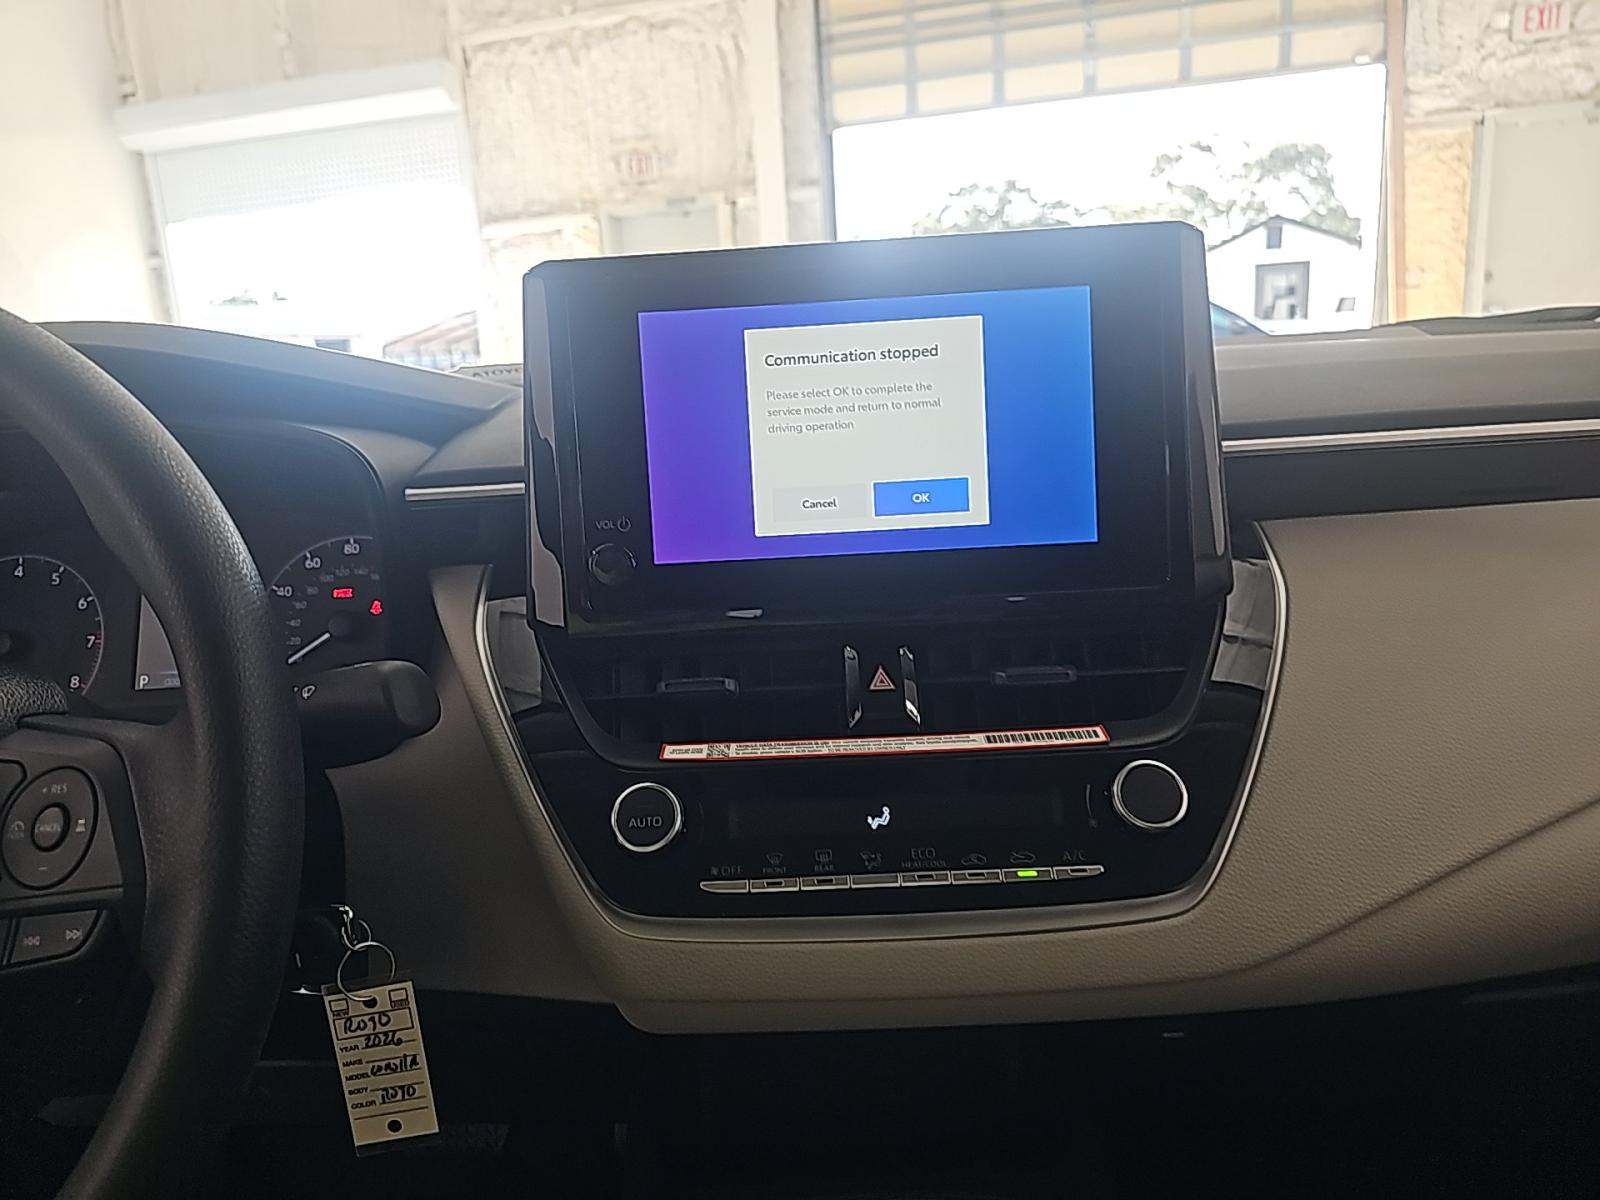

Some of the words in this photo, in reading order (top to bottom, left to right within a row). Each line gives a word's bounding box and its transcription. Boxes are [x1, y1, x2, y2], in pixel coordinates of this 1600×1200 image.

[1524, 1, 1563, 33] EXIT
[764, 350, 876, 367] Communication
[879, 344, 939, 361] stopped
[766, 388, 799, 401] Please
[801, 387, 831, 399] select
[832, 387, 850, 397] OK
[851, 386, 863, 396] to
[864, 383, 914, 397] complete
[915, 381, 933, 392] the
[767, 405, 802, 417] service
[803, 403, 834, 416] mode
[835, 402, 856, 414] and
[858, 401, 889, 413] return
[891, 400, 903, 410] to
[904, 398, 942, 410] normal
[768, 422, 803, 434] driving
[805, 420, 854, 432] operation
[802, 498, 837, 509] Cancel
[912, 493, 930, 503] OK
[595, 520, 615, 530] VOL
[344, 543, 360, 555] 80
[304, 557, 321, 569] 60
[14, 566, 24, 578] 4
[51, 573, 60, 585] 5
[276, 586, 292, 597] 40
[77, 597, 88, 610] 6
[86, 635, 96, 648] 7
[69, 675, 80, 689] 8
[139, 675, 149, 689] P
[629, 816, 662, 828] AUTO
[911, 847, 936, 859] ECO
[1063, 849, 1088, 861] A/C
[721, 864, 743, 876] OFF
[364, 1031, 404, 1049] 2026
[339, 1045, 360, 1053] YEAR
[342, 1059, 363, 1067] MAKE
[345, 1072, 371, 1082] MODEL
[348, 1087, 369, 1096] BODY
[351, 1099, 377, 1110] COLOR
